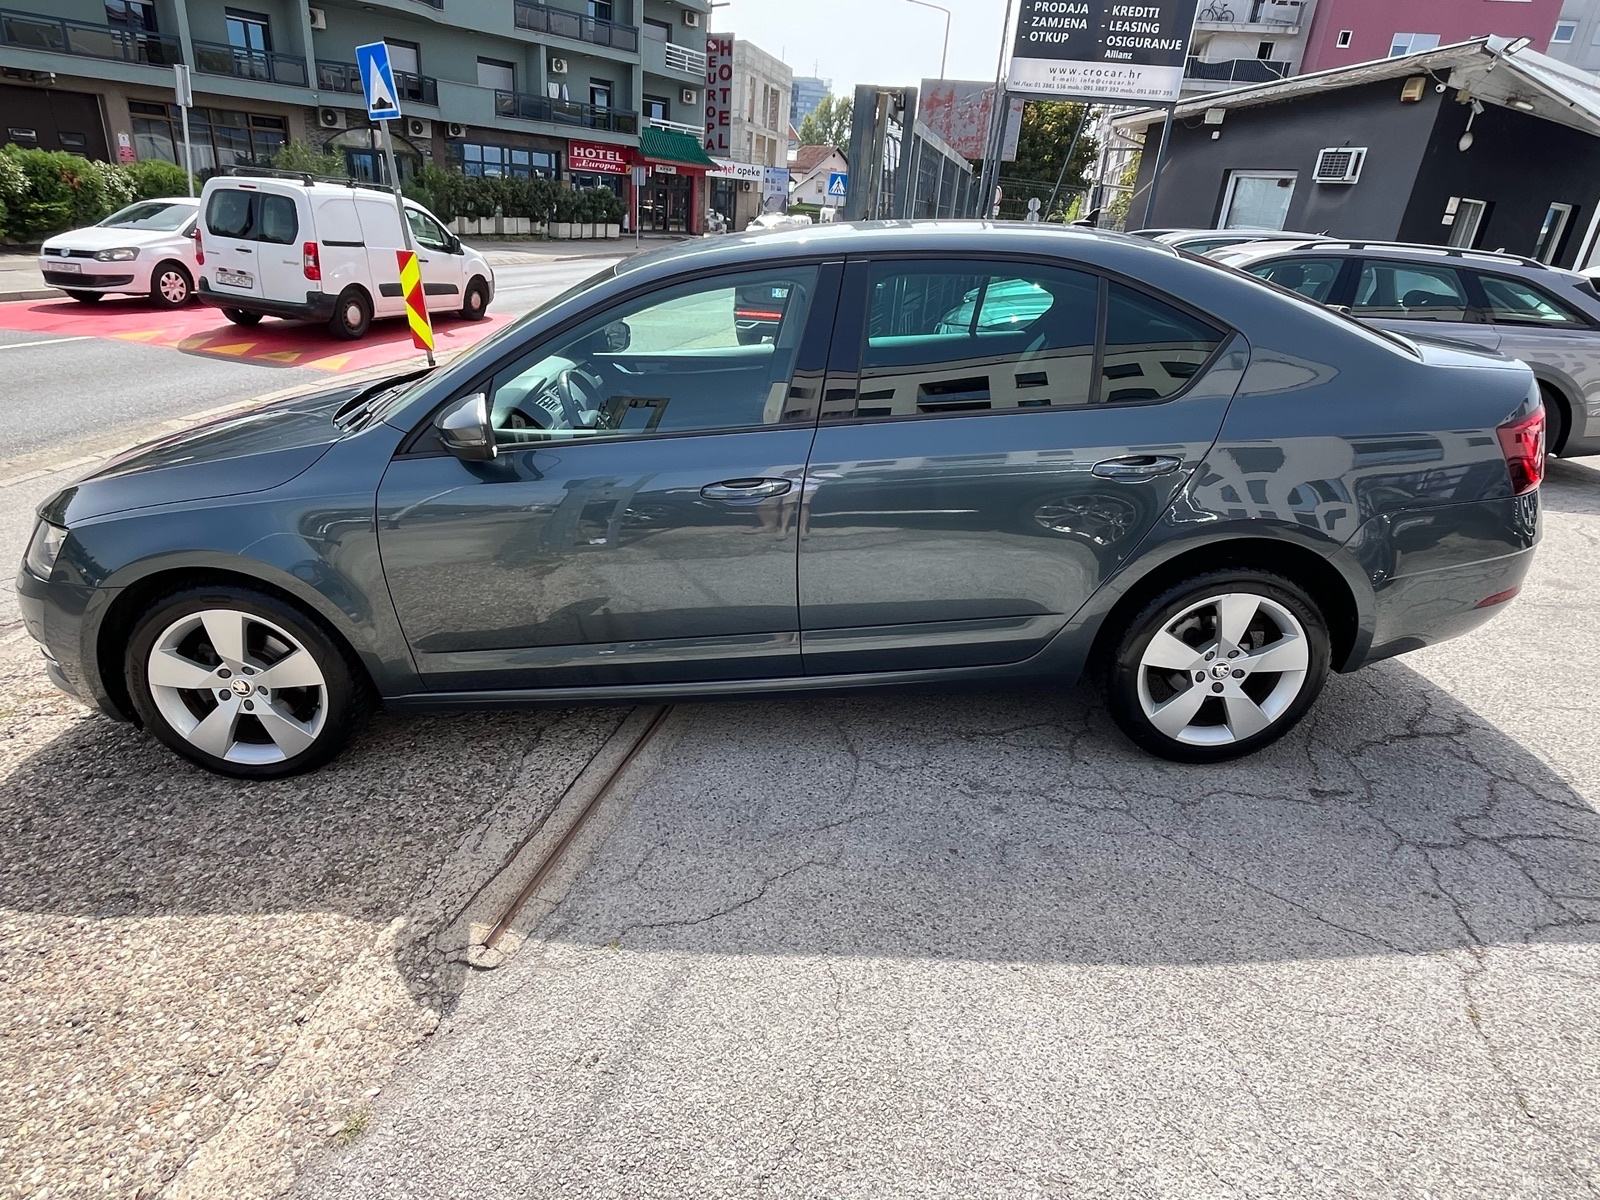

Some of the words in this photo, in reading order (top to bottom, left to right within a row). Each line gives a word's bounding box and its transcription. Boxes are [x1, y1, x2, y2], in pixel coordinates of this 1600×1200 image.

[1034, 1, 1089, 15] PRODAJA
[1112, 5, 1160, 19] KREDITI
[1031, 16, 1088, 30] ZAMJENA
[1109, 20, 1160, 34] LEASING
[1029, 31, 1069, 44] OTKUP
[1106, 36, 1183, 51] OSIGURANJE
[1104, 50, 1133, 60] Allianz
[1049, 66, 1142, 78] www.crocar.hr
[718, 39, 733, 150] HOTEL
[705, 55, 717, 151] EUROPA
[573, 146, 624, 162] HOTEL
[737, 166, 761, 178] opeke
